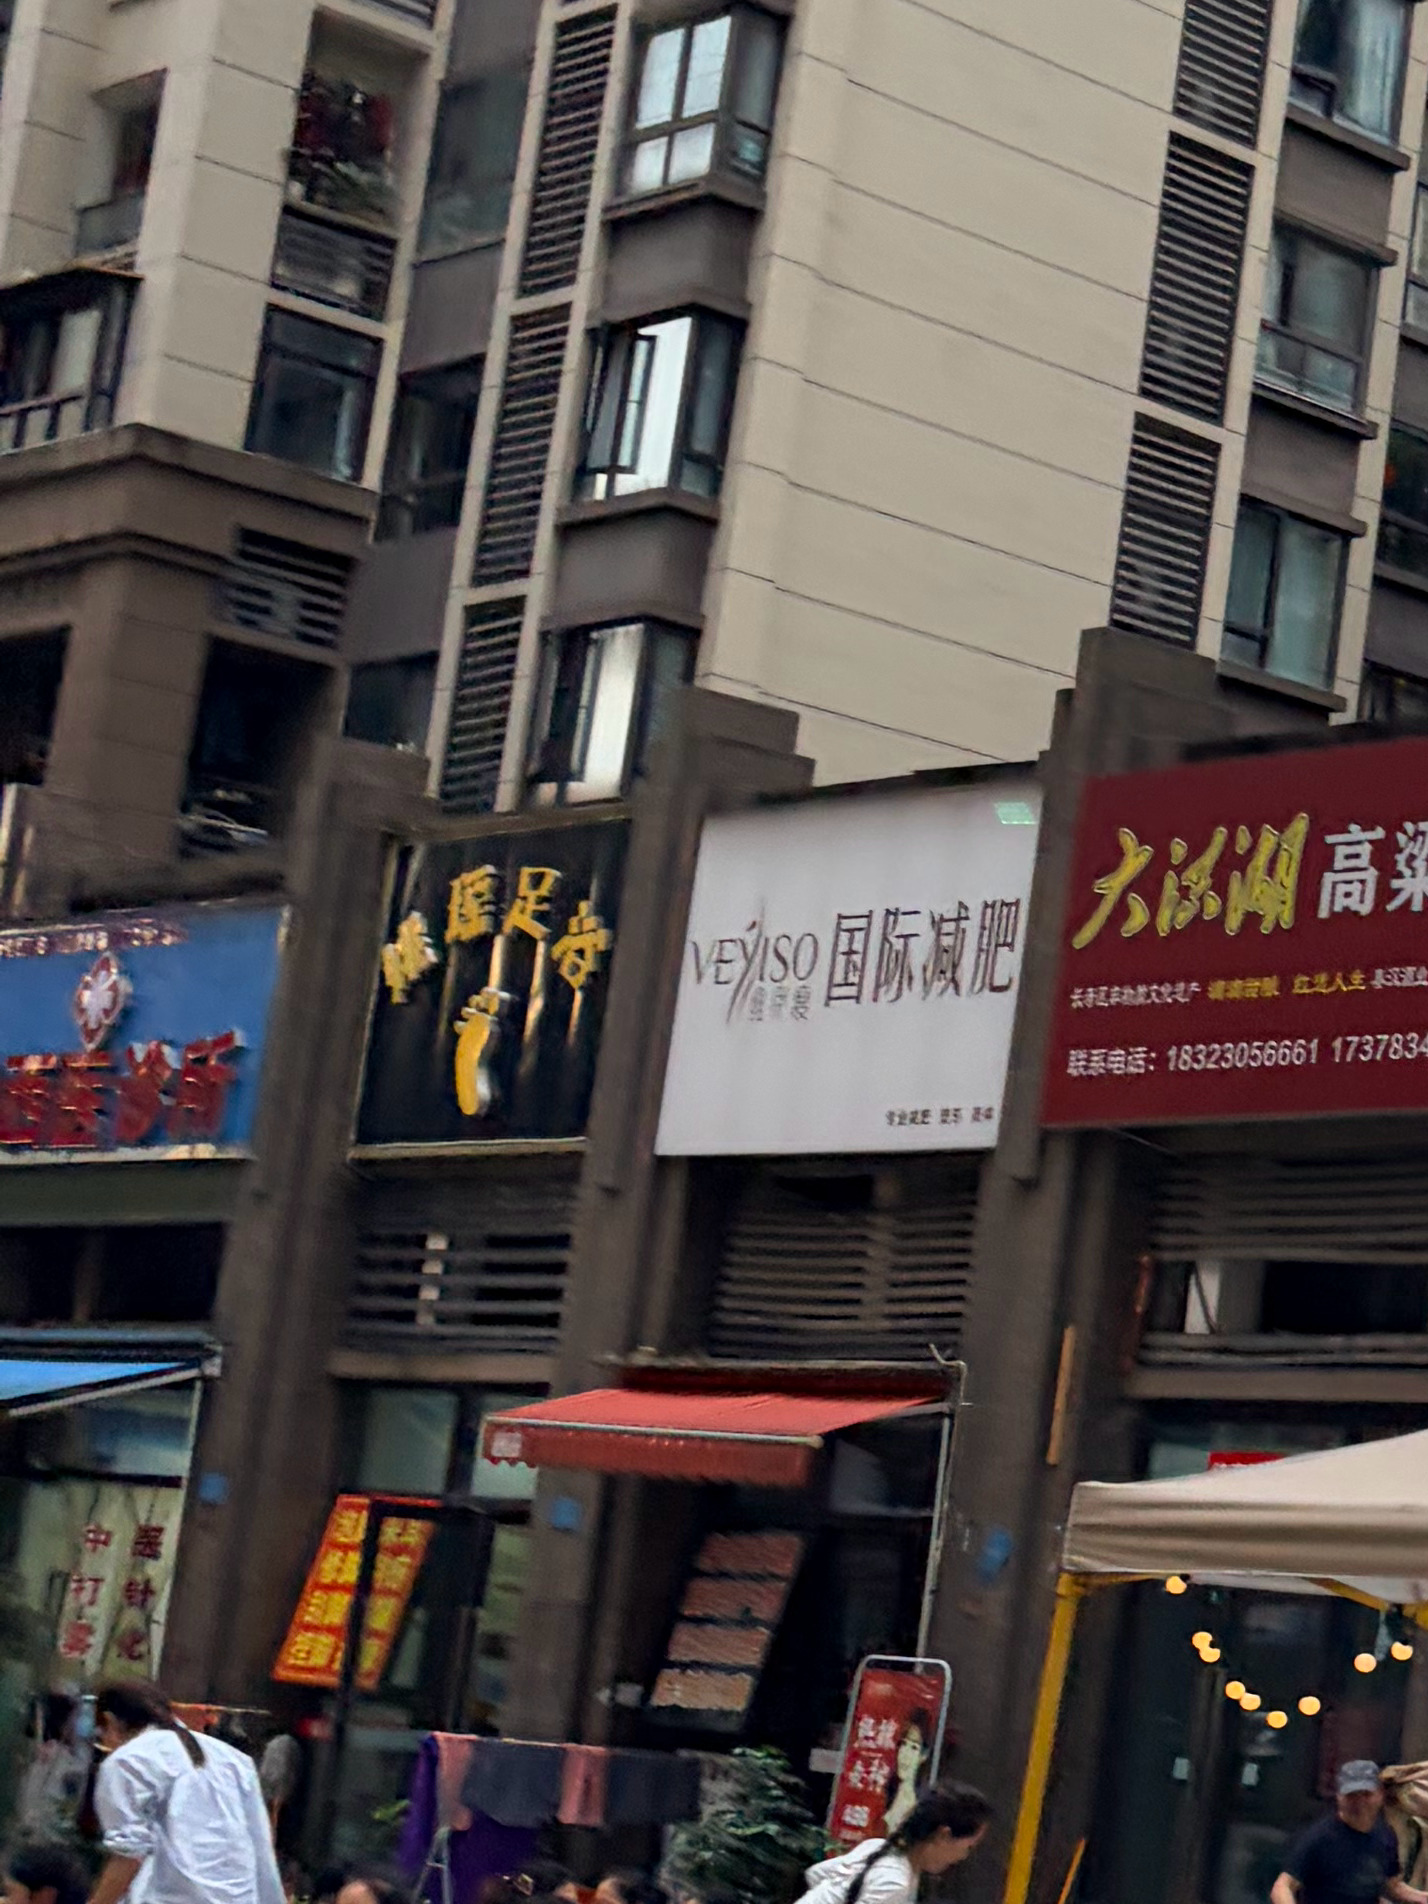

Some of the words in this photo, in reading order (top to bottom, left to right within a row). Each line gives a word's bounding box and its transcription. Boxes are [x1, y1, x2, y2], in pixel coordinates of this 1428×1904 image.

[824, 898, 1020, 1007] 国际减肥
[1167, 1038, 1320, 1072] 18323056661
